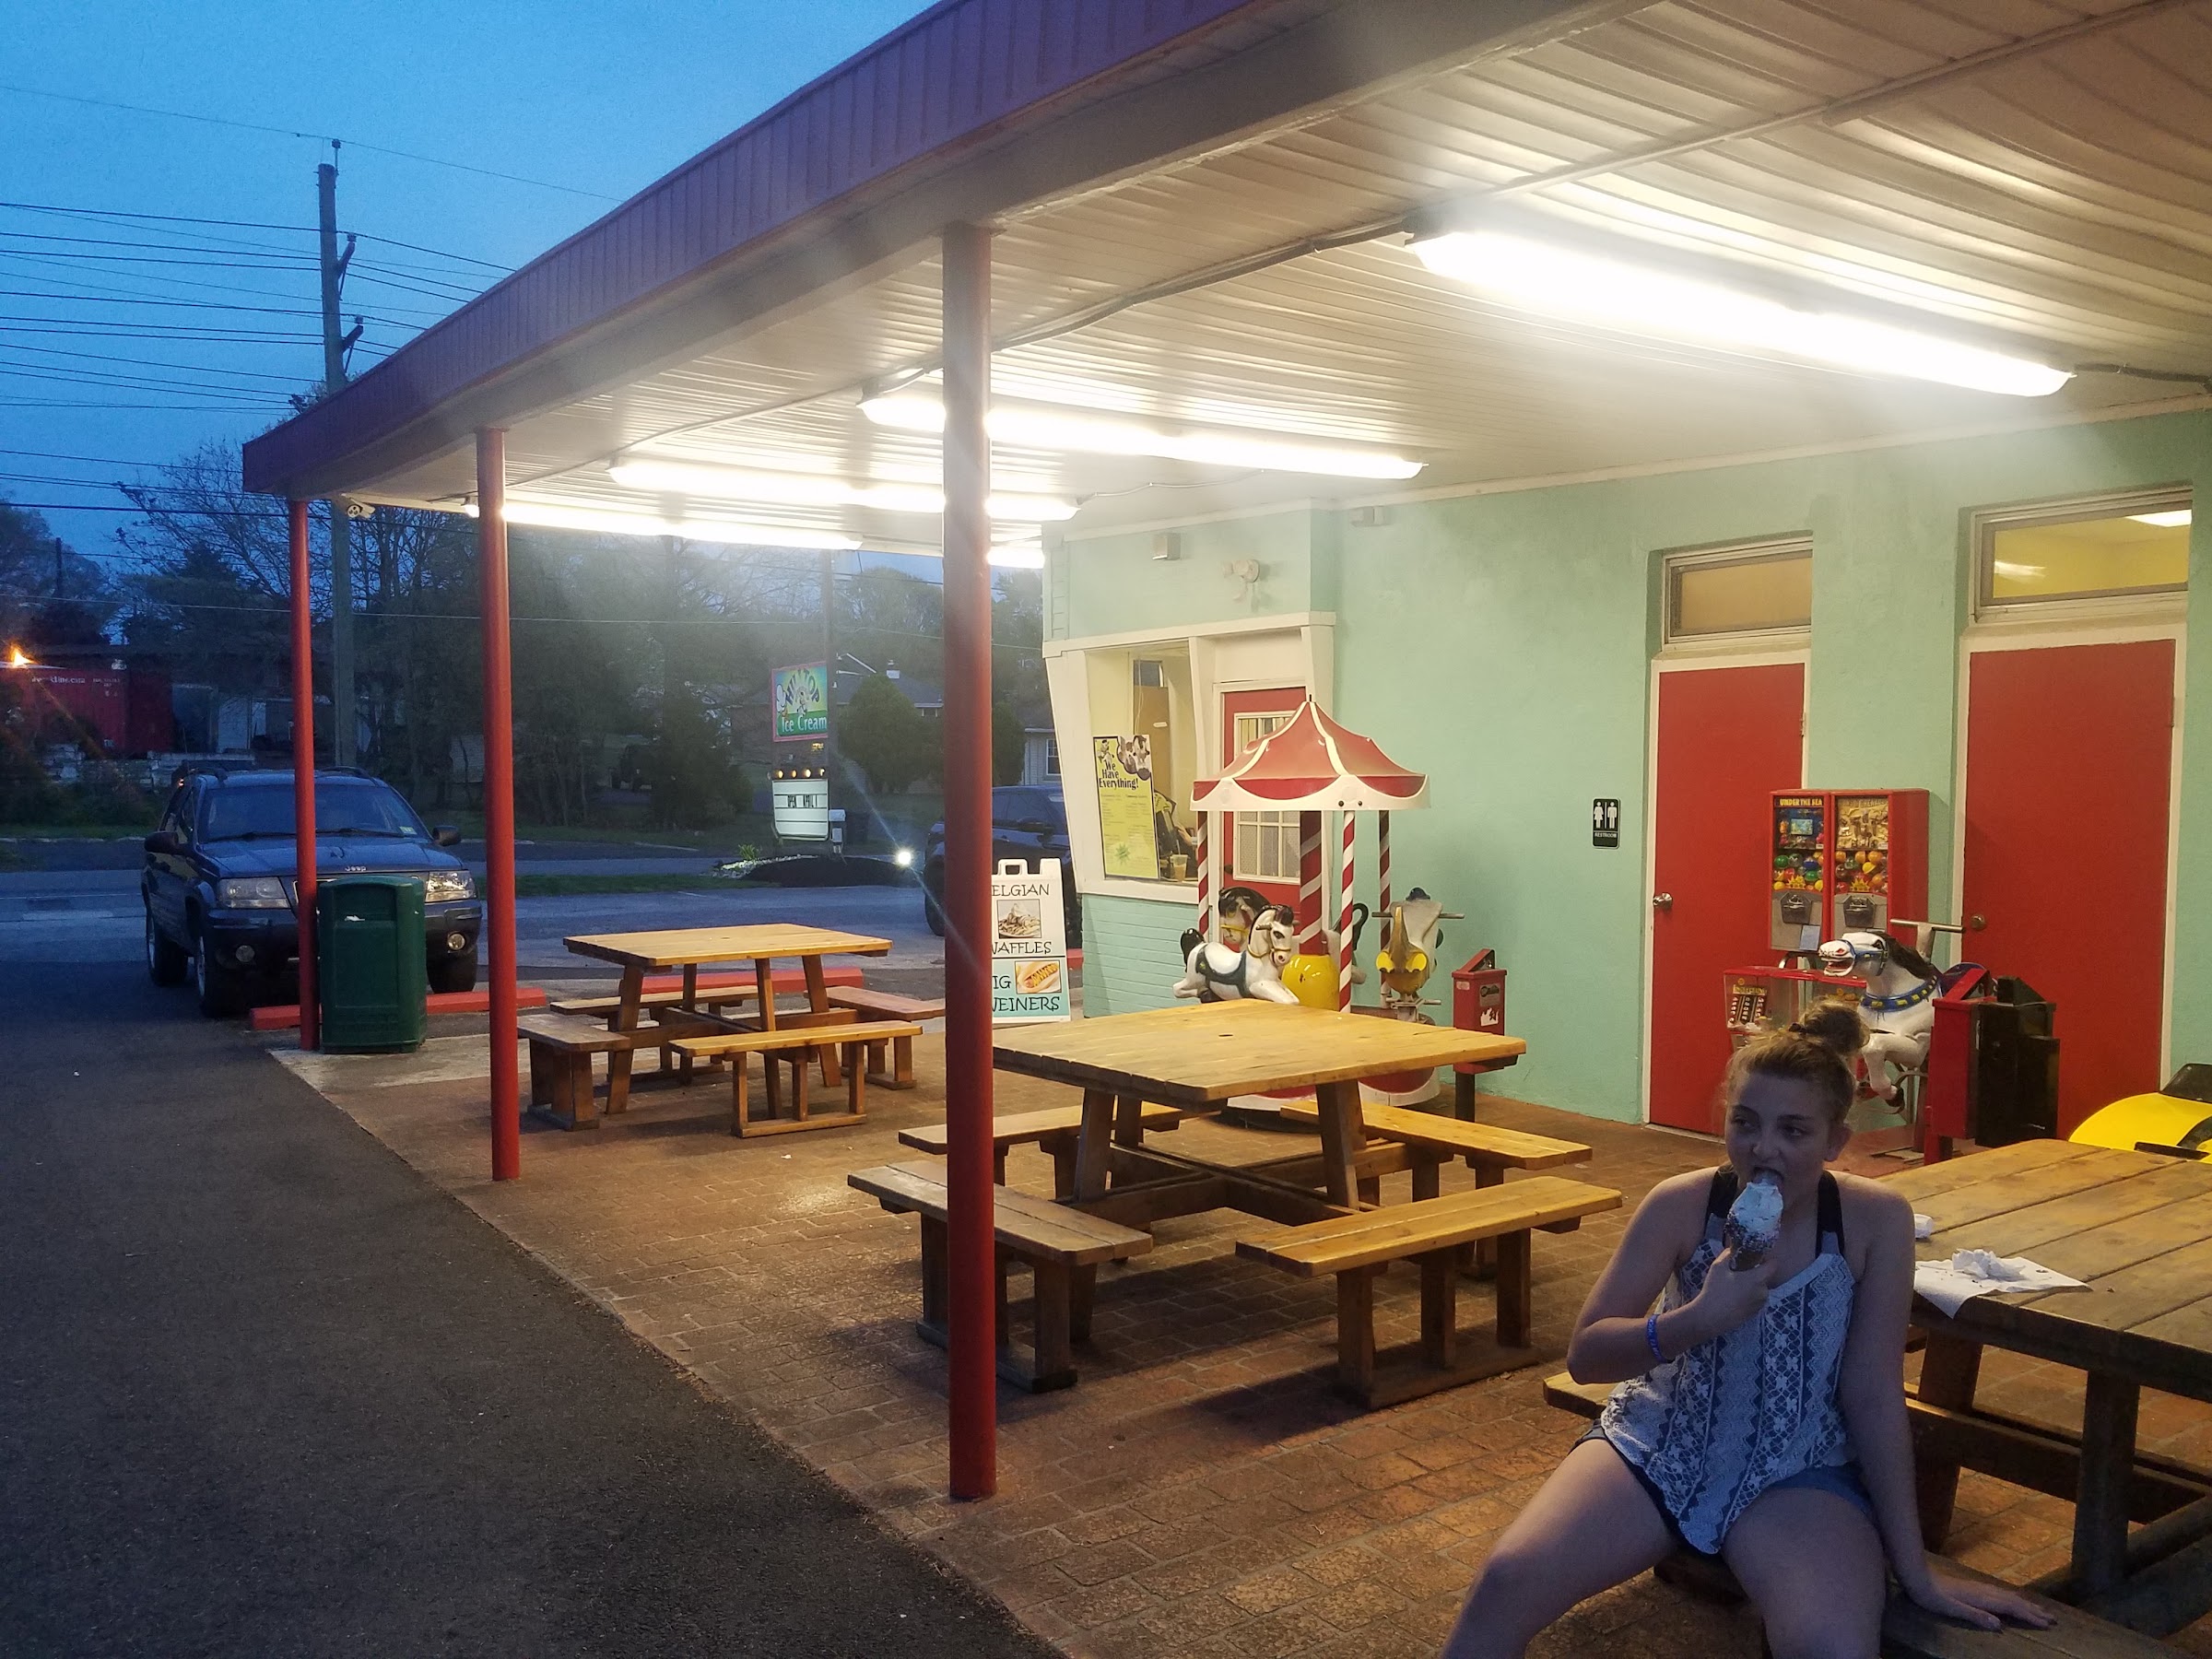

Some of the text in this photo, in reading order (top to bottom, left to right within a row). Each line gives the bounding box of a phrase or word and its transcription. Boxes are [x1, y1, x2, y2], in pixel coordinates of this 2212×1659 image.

[782, 714, 828, 733] Ice Cream
[1105, 759, 1116, 771] We
[1101, 769, 1120, 779] Have
[1099, 778, 1139, 791] Everything!
[992, 883, 1050, 897] ELGIAN
[993, 975, 1012, 989] IG
